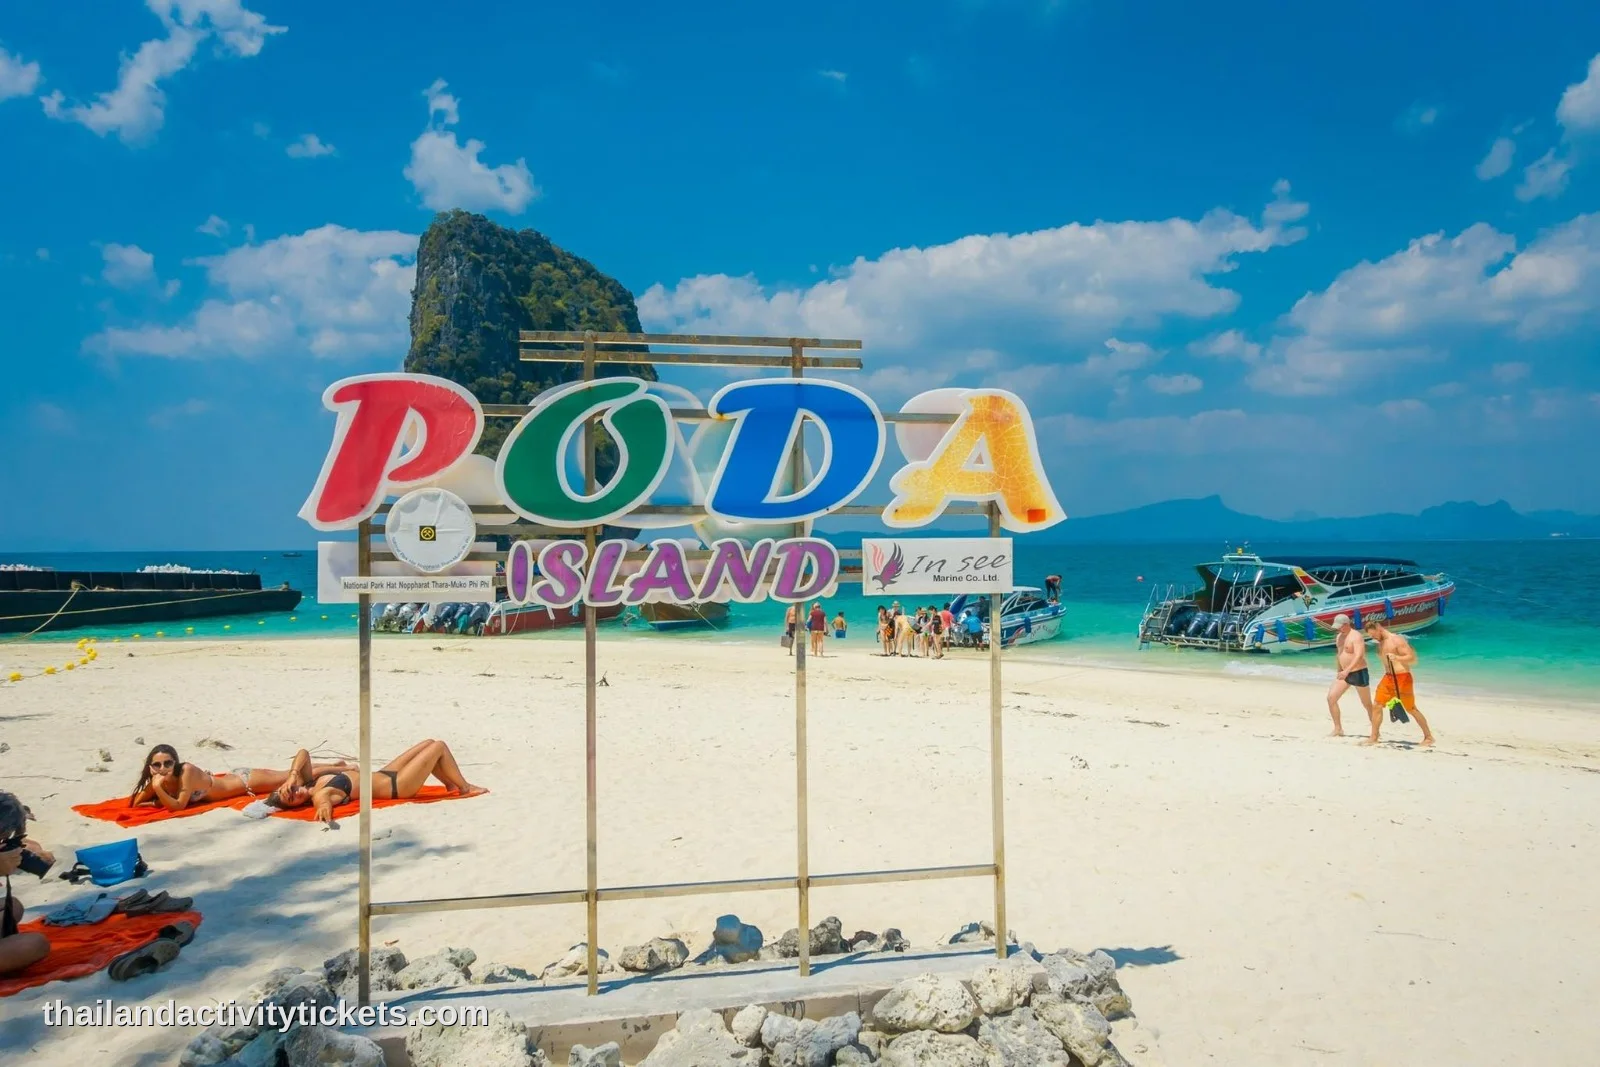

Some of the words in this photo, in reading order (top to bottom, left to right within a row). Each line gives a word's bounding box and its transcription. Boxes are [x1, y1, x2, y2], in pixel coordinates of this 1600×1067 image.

[312, 378, 1056, 526] PODA
[510, 541, 836, 603] ISLAND
[907, 555, 947, 575] In
[343, 580, 369, 591] National
[370, 580, 384, 590] Park
[386, 580, 397, 590] Hat
[398, 580, 430, 591] Noppharat
[431, 580, 467, 590] Thara-Muko
[468, 580, 478, 590] Phi
[479, 580, 490, 590] Phi
[933, 574, 964, 583] Marine
[982, 573, 1000, 583] Ltd.
